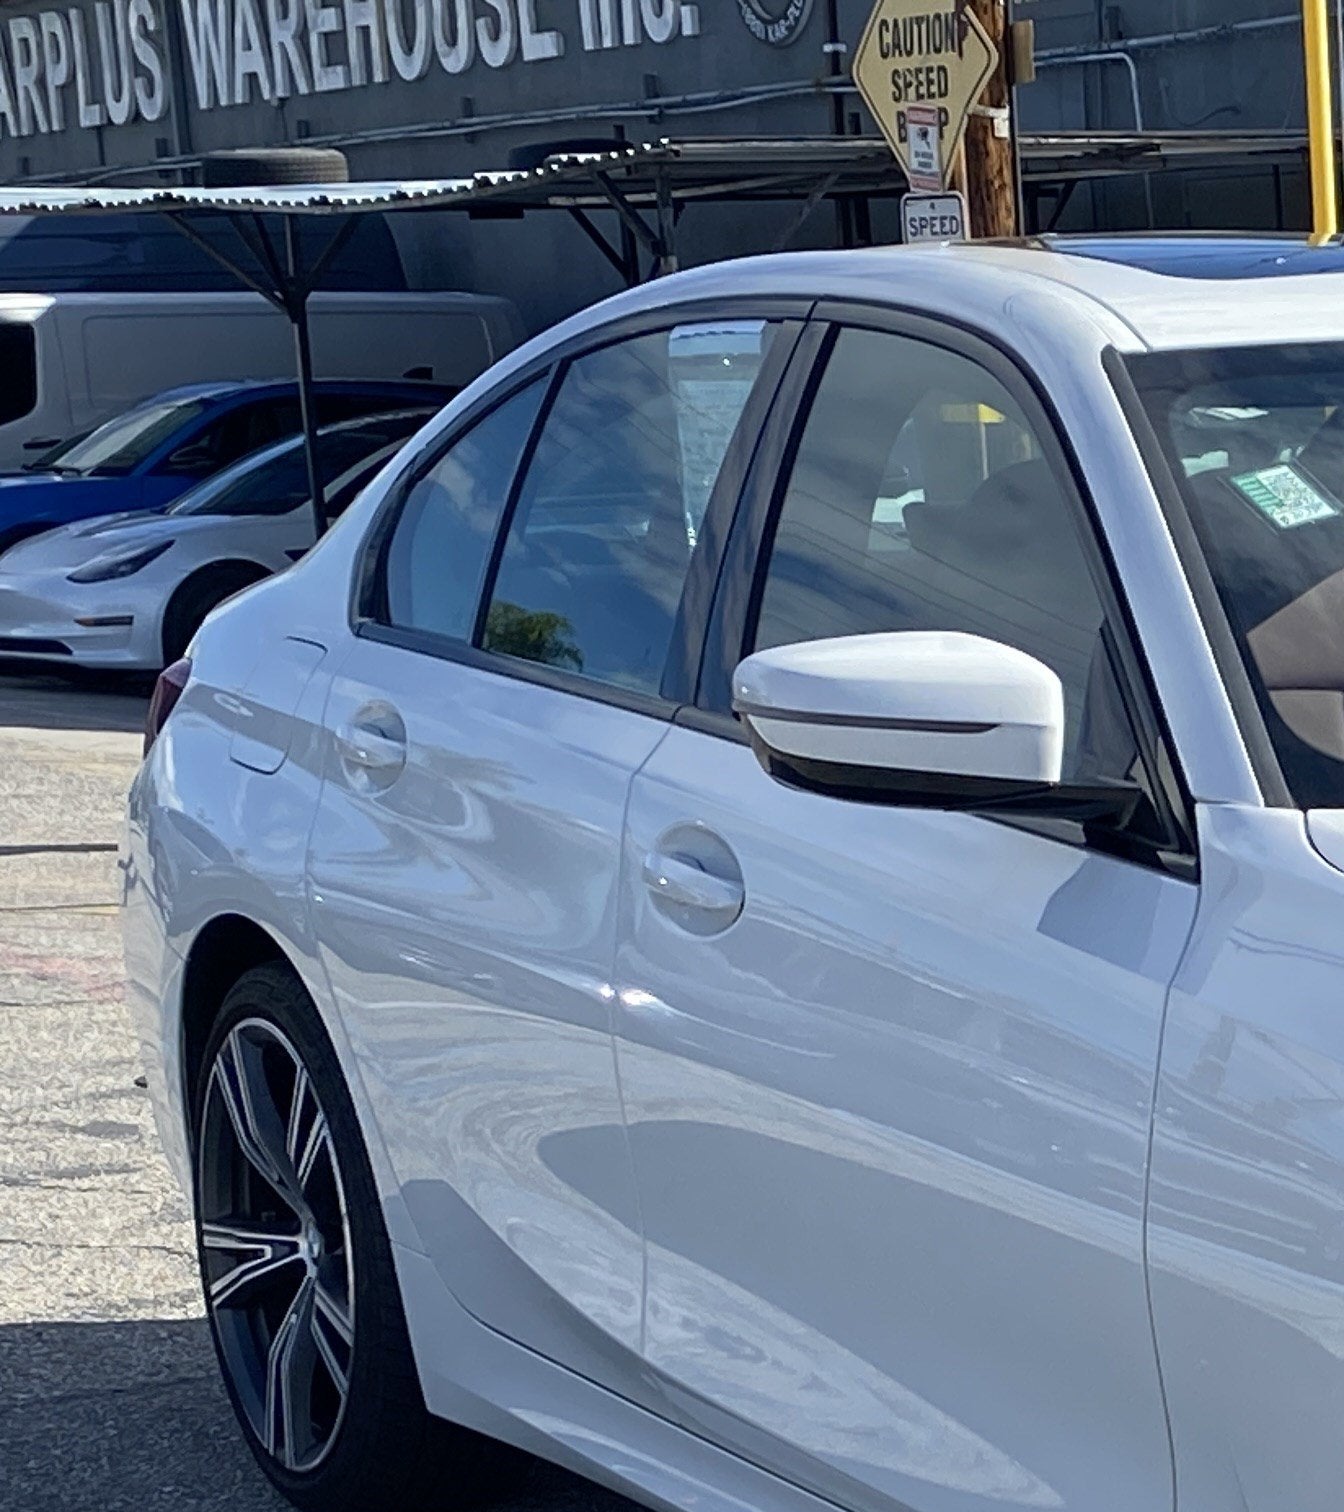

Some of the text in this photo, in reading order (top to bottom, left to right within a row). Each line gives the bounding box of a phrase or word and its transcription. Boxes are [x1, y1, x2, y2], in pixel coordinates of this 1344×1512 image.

[879, 11, 958, 60] CAUTION
[891, 64, 949, 103] SPEED
[896, 106, 950, 144] BP
[909, 215, 960, 238] SPEED
